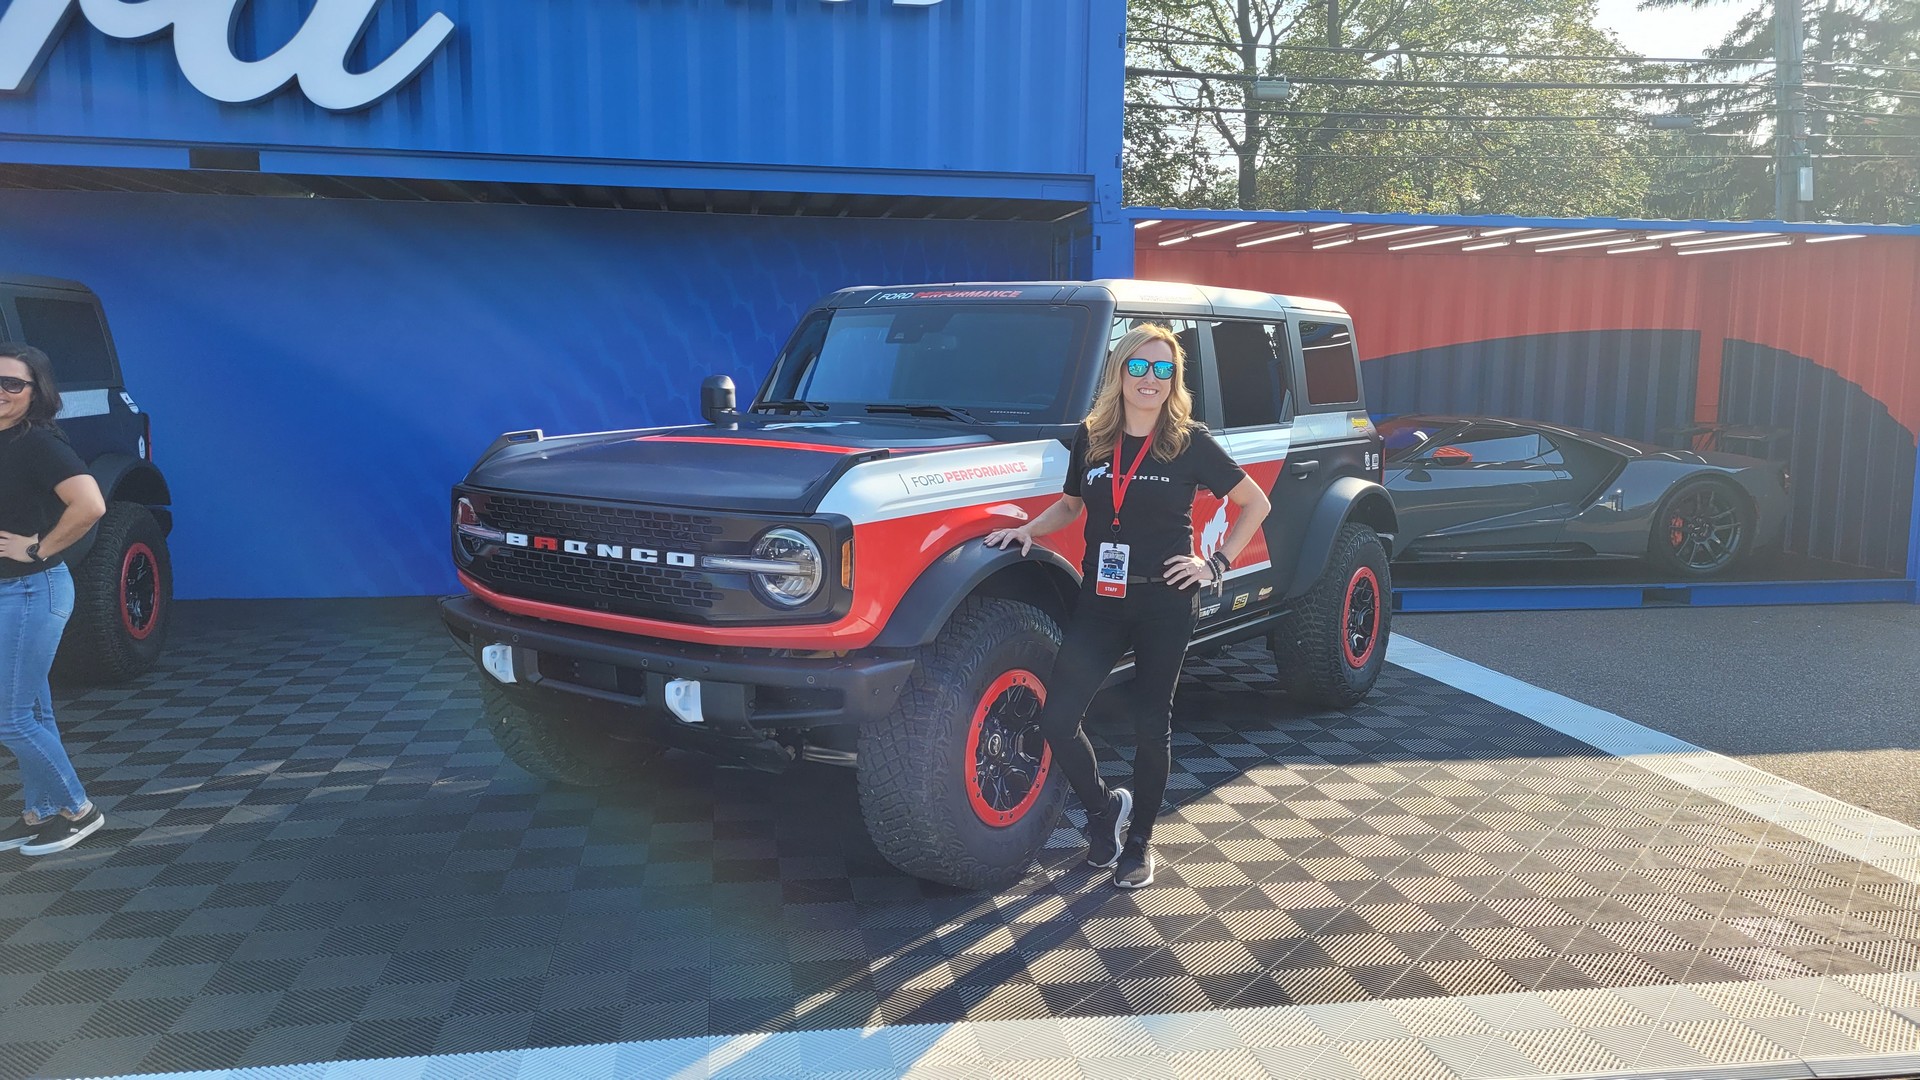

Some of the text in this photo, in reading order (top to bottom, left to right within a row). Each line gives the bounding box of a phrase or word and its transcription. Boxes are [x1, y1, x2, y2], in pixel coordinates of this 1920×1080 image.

[878, 290, 1023, 300] FORD PERFORMANCE
[911, 461, 1028, 488] FORD PERFORMANCE
[506, 532, 695, 567] BRONCO
